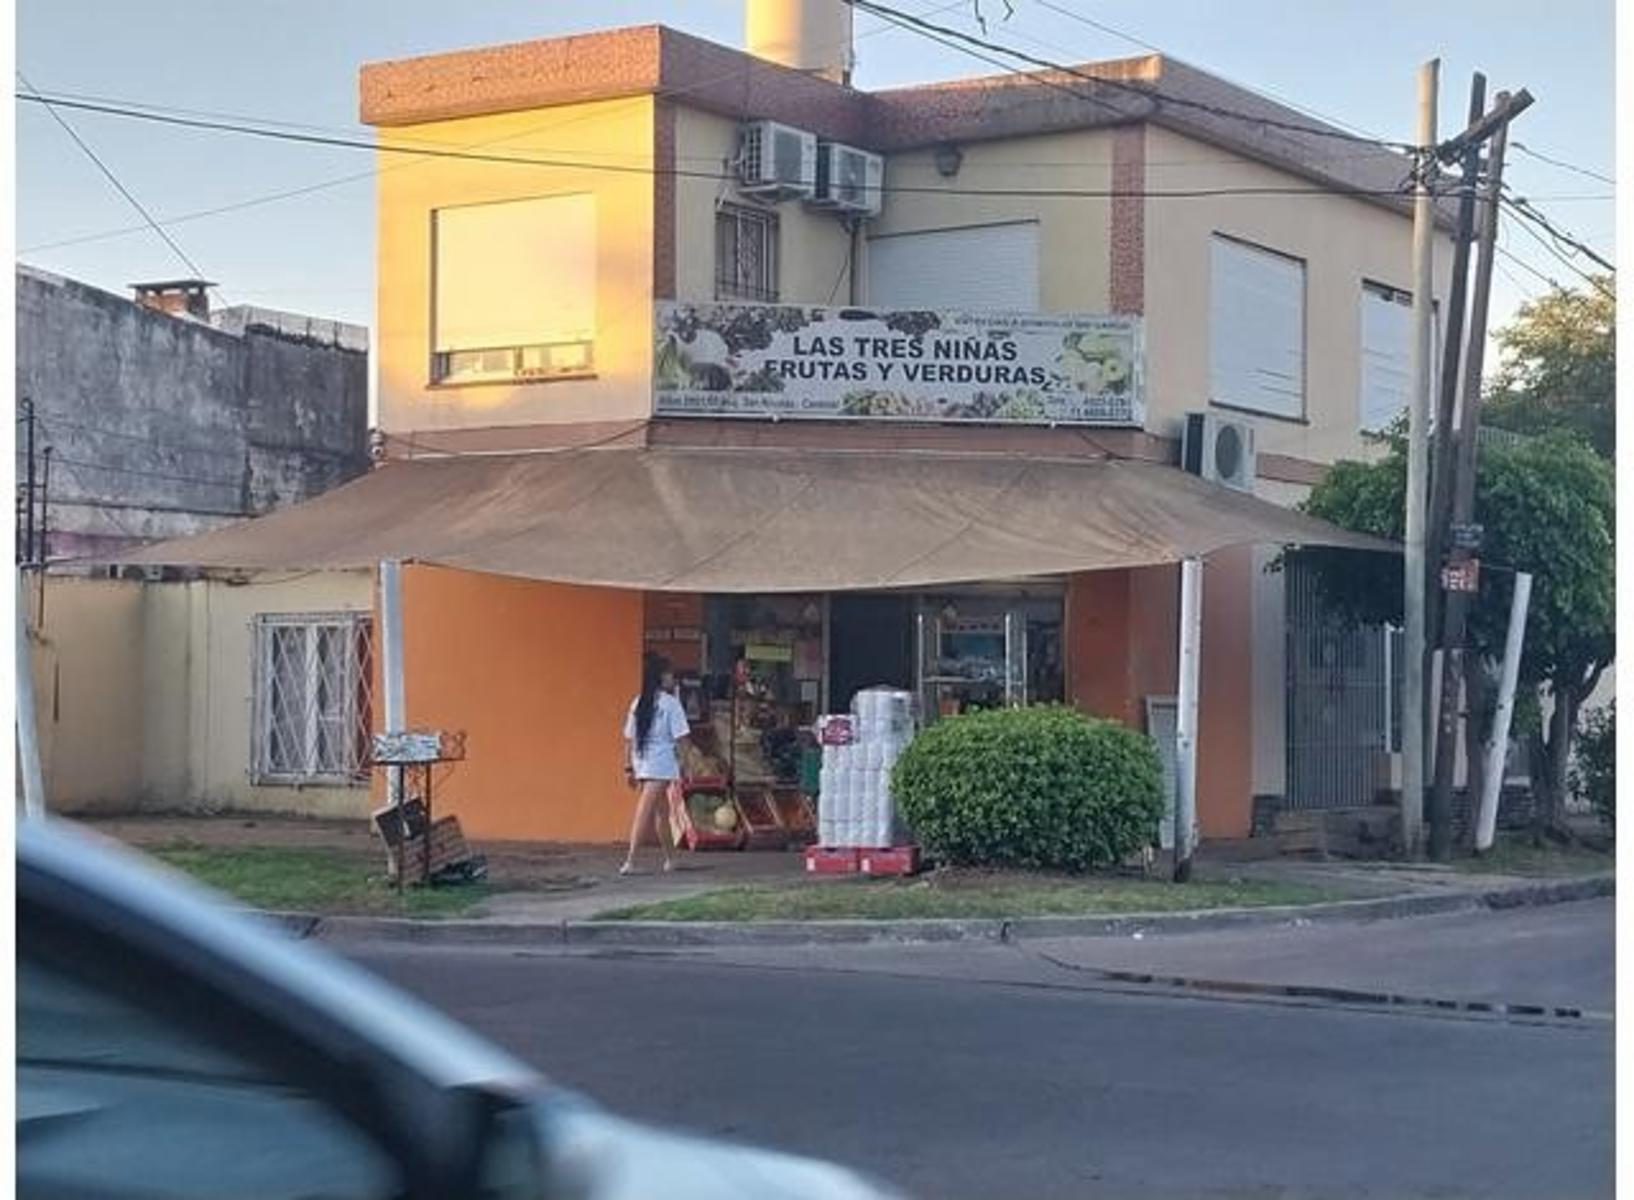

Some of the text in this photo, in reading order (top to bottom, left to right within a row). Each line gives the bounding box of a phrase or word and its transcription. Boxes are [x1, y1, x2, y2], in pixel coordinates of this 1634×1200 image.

[793, 336, 1017, 361] LAS TRES NIÑAS
[765, 360, 1046, 385] FRUTAS Y VERDURAS
